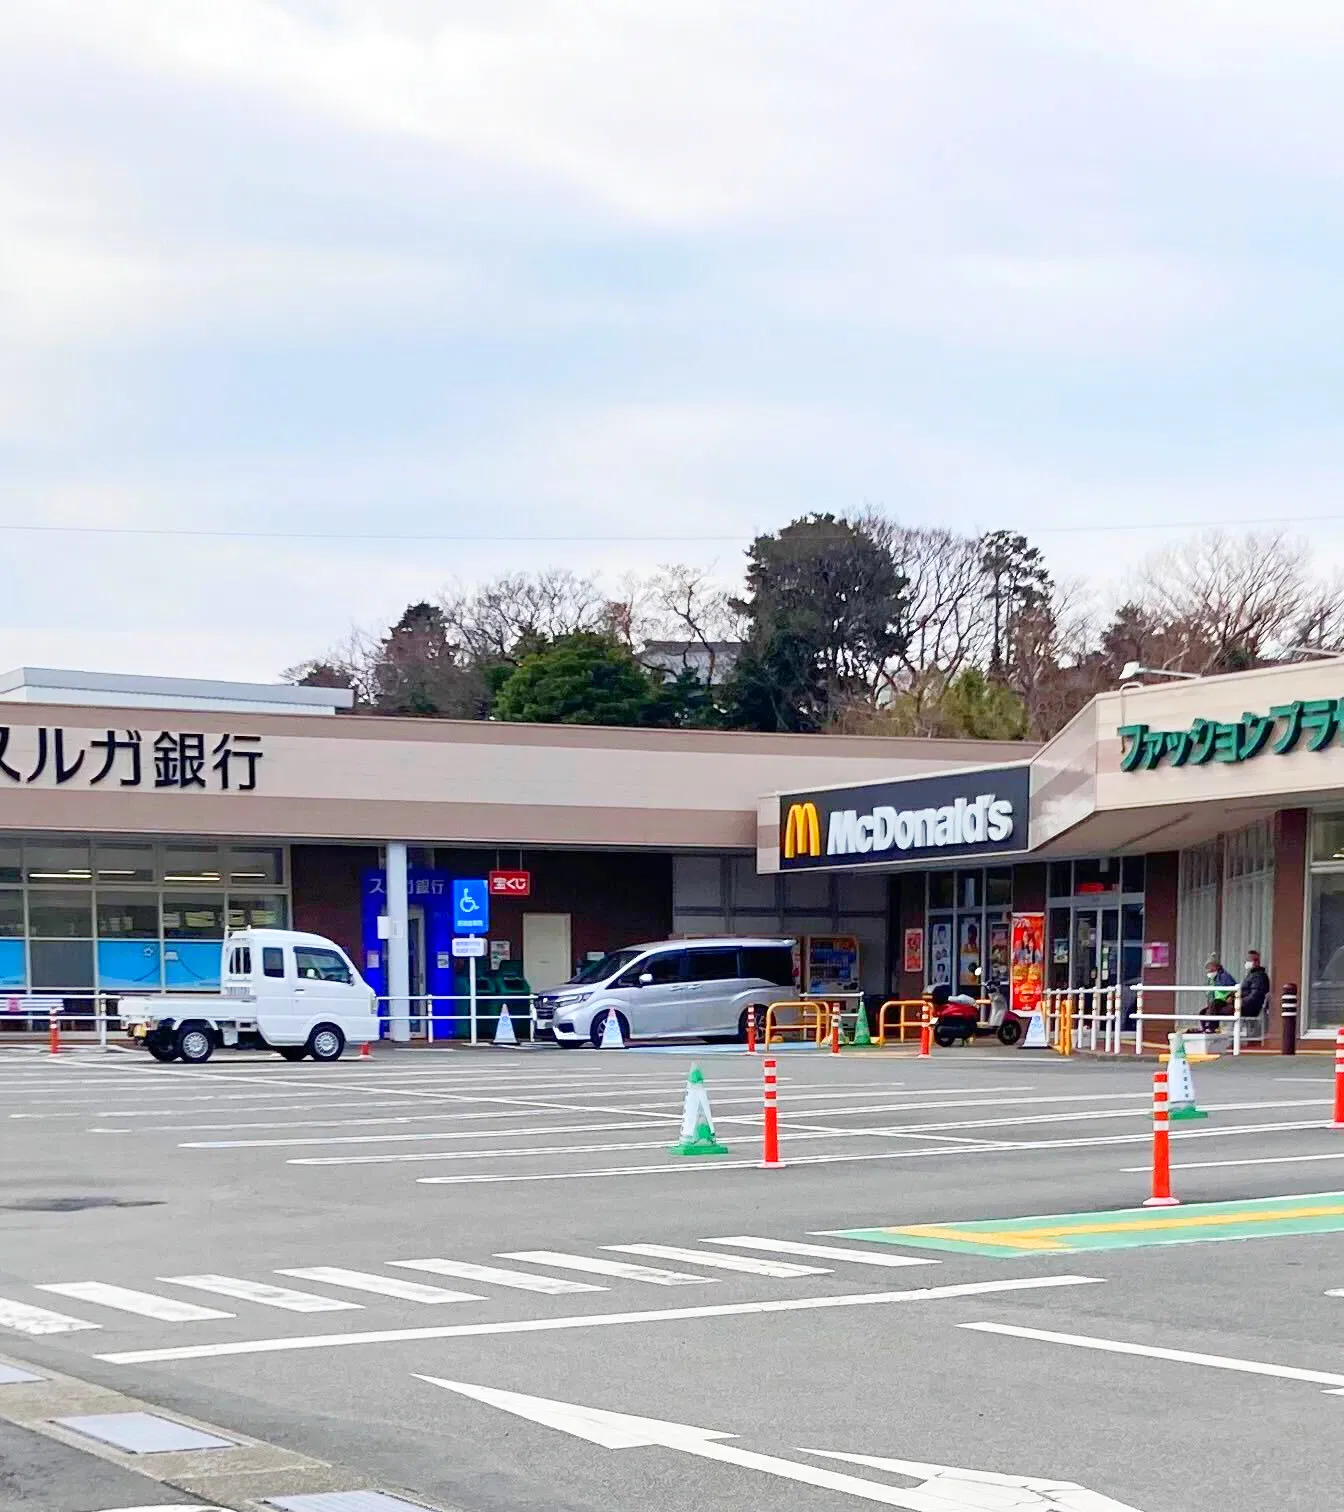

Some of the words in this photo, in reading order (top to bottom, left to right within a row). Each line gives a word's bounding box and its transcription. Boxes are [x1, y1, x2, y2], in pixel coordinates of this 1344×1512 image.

[827, 794, 1014, 856] McDonald's
[369, 878, 445, 895] ス銀行
[493, 877, 527, 890] 宝くじ
